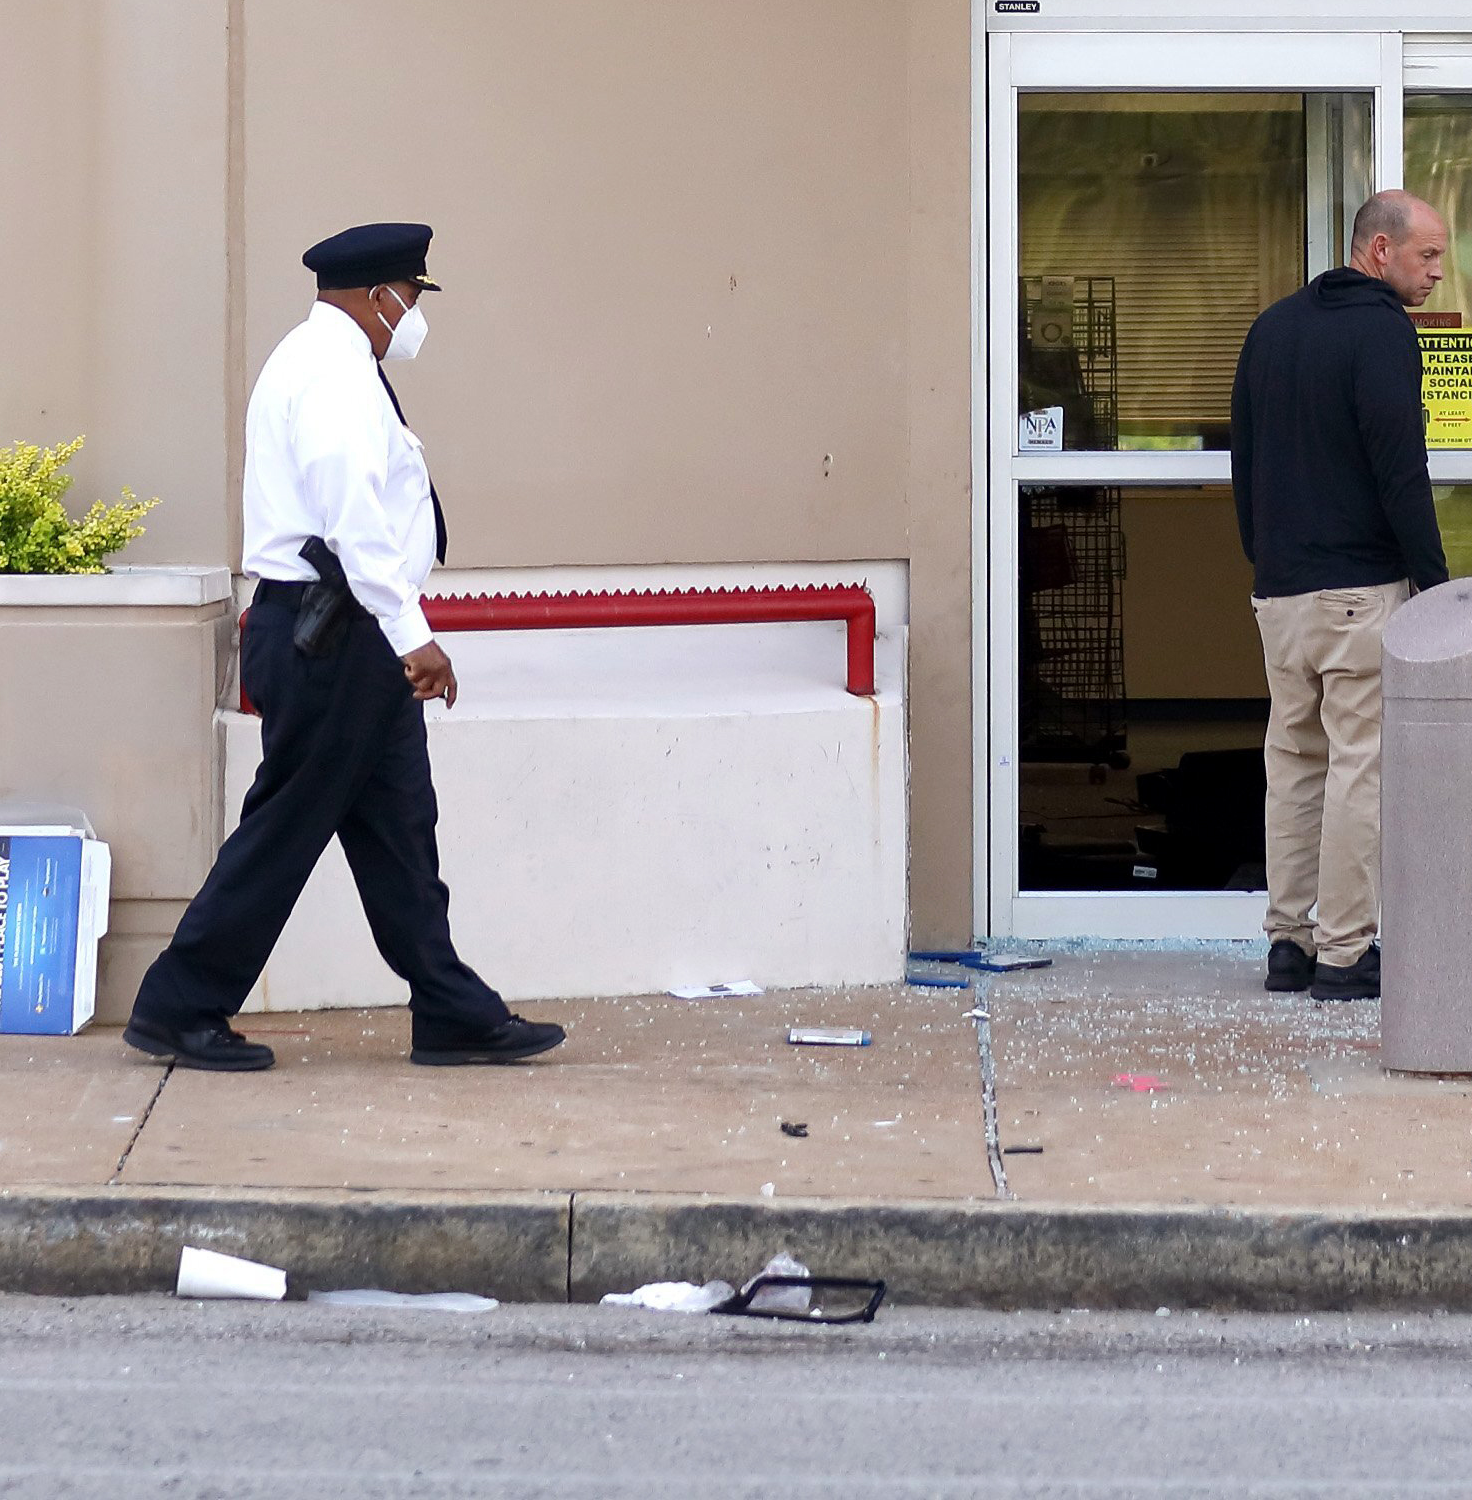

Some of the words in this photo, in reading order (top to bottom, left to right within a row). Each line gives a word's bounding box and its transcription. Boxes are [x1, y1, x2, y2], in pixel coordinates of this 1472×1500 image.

[998, 3, 1037, 11] STANLEY
[1413, 318, 1451, 327] MOKING
[1026, 417, 1056, 433] NPA
